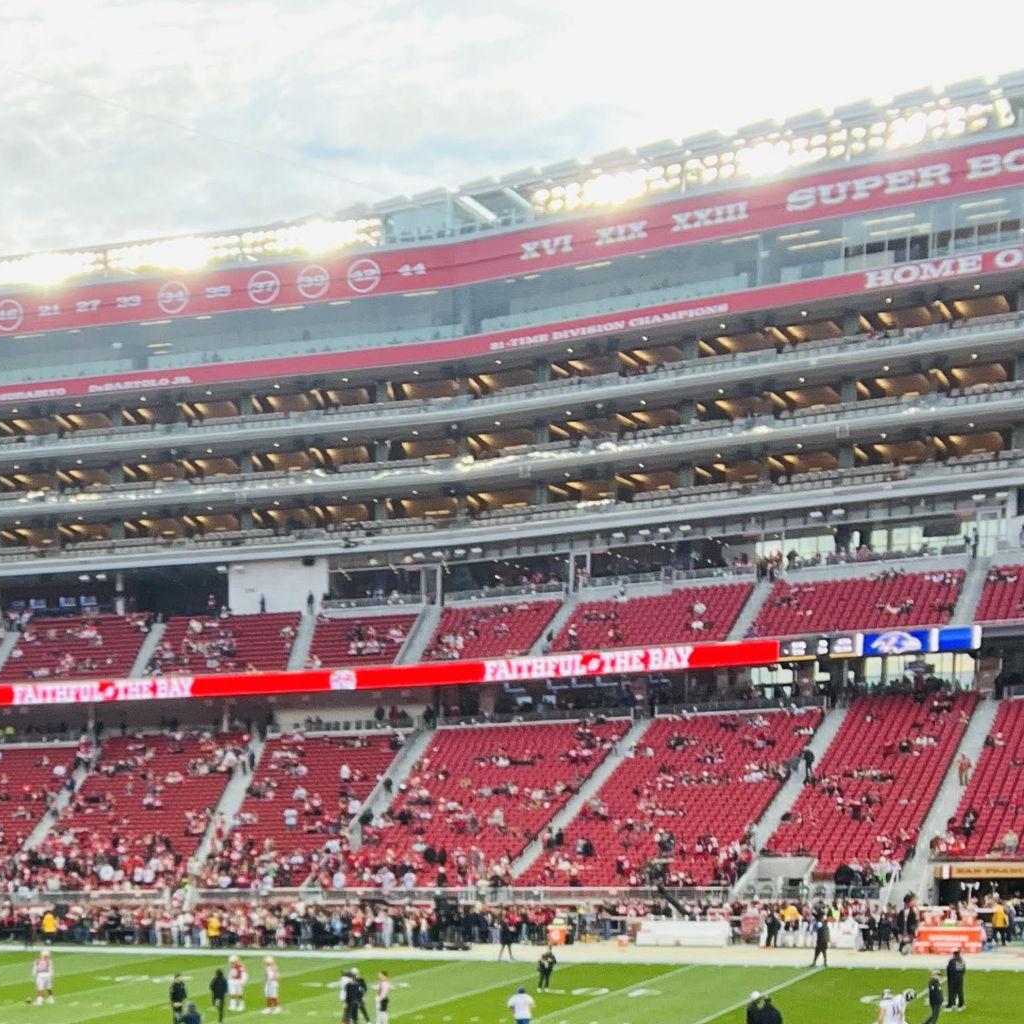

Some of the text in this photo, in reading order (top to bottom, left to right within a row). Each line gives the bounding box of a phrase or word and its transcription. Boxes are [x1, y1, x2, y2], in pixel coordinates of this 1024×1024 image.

[786, 163, 952, 212] SUPER
[520, 201, 749, 260] XVI XIX XXIII
[864, 253, 983, 289] HOME
[552, 320, 625, 341] DIVISION
[628, 303, 729, 328] CHAMPIONS
[484, 646, 693, 682] FAITHFUL THE BAY
[13, 677, 193, 705] FAITHFUL THE BAY
